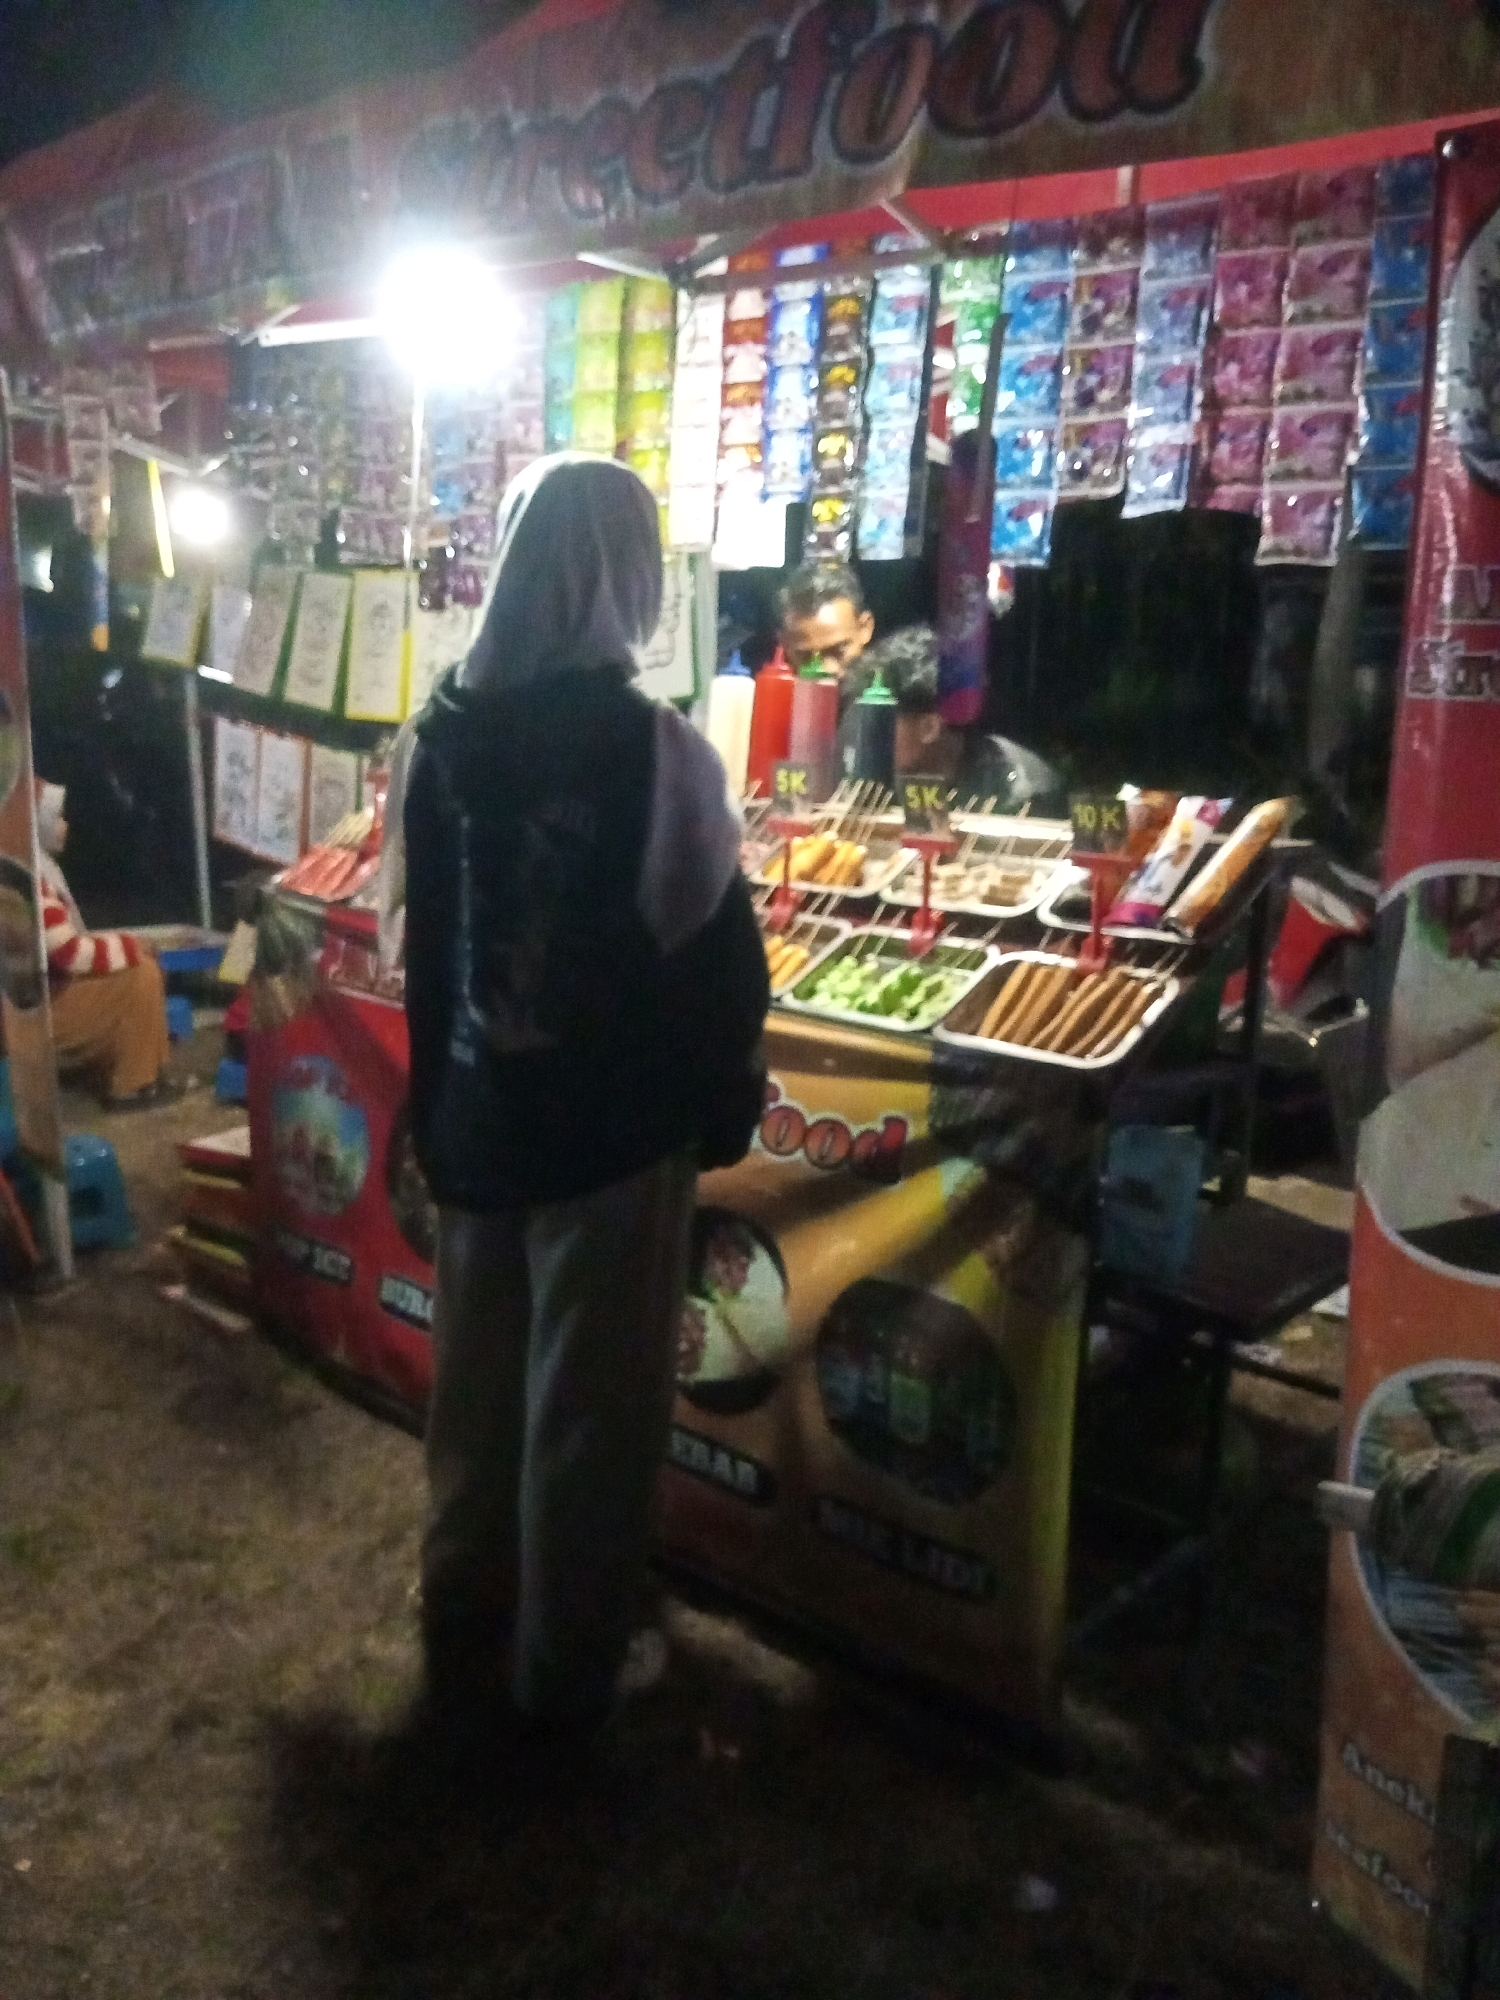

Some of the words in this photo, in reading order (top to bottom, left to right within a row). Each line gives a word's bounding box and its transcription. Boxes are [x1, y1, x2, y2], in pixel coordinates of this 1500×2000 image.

[904, 783, 943, 810] 5K
[762, 1082, 908, 1184] ood
[1343, 1742, 1436, 1826] Anek
